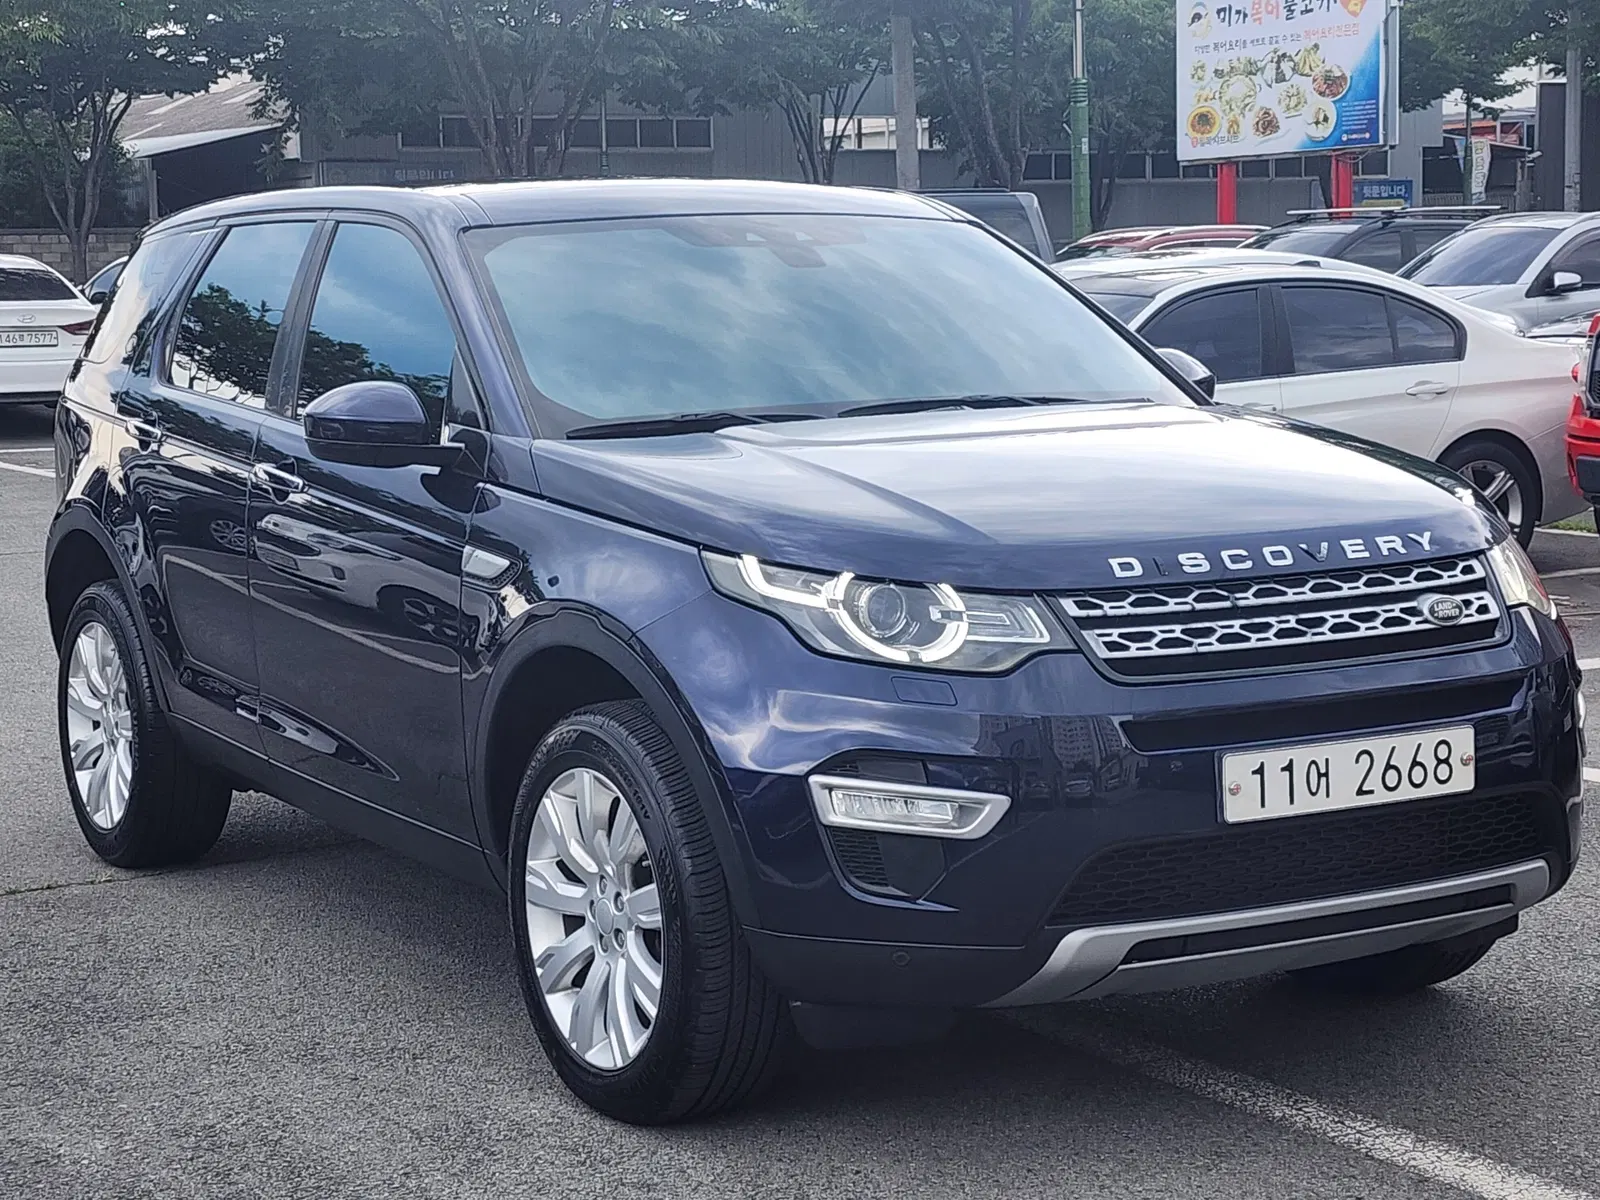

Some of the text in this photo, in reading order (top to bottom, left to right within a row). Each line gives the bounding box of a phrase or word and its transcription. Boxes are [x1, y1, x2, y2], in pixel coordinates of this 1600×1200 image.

[27, 333, 53, 344] 7577
[1108, 531, 1432, 578] DISCOVERY
[1434, 601, 1453, 611] LAND
[1438, 608, 1460, 618] ROVER
[1251, 738, 1454, 809] 11어 2668
